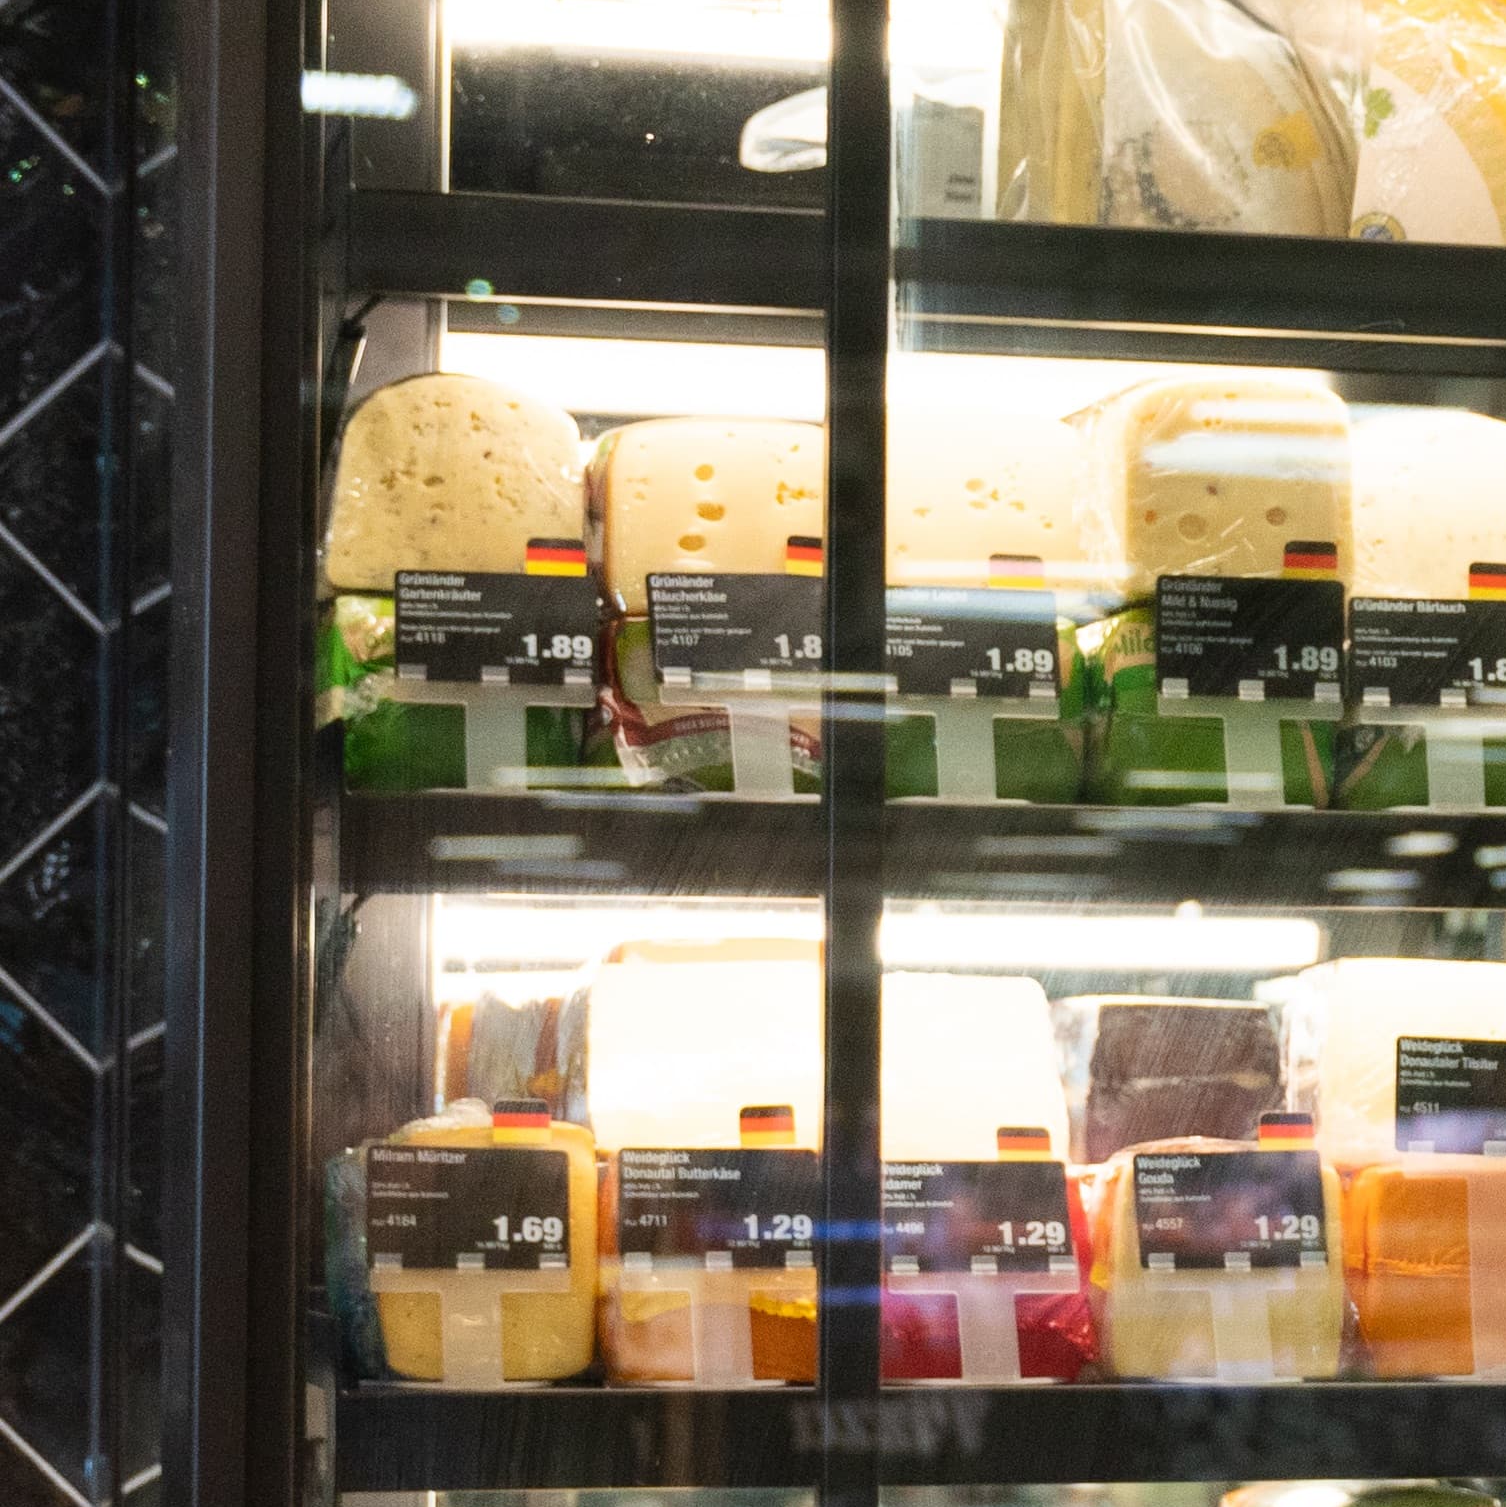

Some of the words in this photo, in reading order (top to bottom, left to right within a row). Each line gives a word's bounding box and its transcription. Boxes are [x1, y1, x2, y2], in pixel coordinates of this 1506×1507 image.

[399, 574, 466, 587] Grünländer
[650, 576, 716, 589] Grünländer
[1160, 579, 1224, 593] Grünländer
[399, 587, 483, 602] Gartenkräuter
[651, 590, 728, 603] Räucherkäse
[1160, 594, 1187, 608] Mild
[1188, 595, 1198, 608] &
[1200, 597, 1239, 612] Nussig
[1353, 599, 1416, 613] Grünländer
[1416, 601, 1467, 614] Bärlauch
[521, 632, 594, 659] 1.89
[671, 634, 700, 647] 4107
[773, 633, 824, 660] 1.8
[985, 646, 1055, 674] 1.89
[1272, 645, 1340, 672] 1.89
[1400, 1039, 1465, 1055] Weideglück
[371, 1148, 415, 1164] Milram
[416, 1148, 468, 1165] Müritzer
[622, 1150, 691, 1166] Weideglück
[1135, 1155, 1203, 1172] Weideglück
[622, 1166, 676, 1181] Donautal
[677, 1167, 742, 1182] Butterkäse
[1137, 1172, 1175, 1185] Gouda
[884, 1178, 924, 1191] damer
[639, 1213, 669, 1228] 4711
[743, 1213, 814, 1241] 1.29
[1254, 1213, 1321, 1241] 1.29
[491, 1214, 564, 1244] 1.69
[998, 1220, 1067, 1247] 1.29
